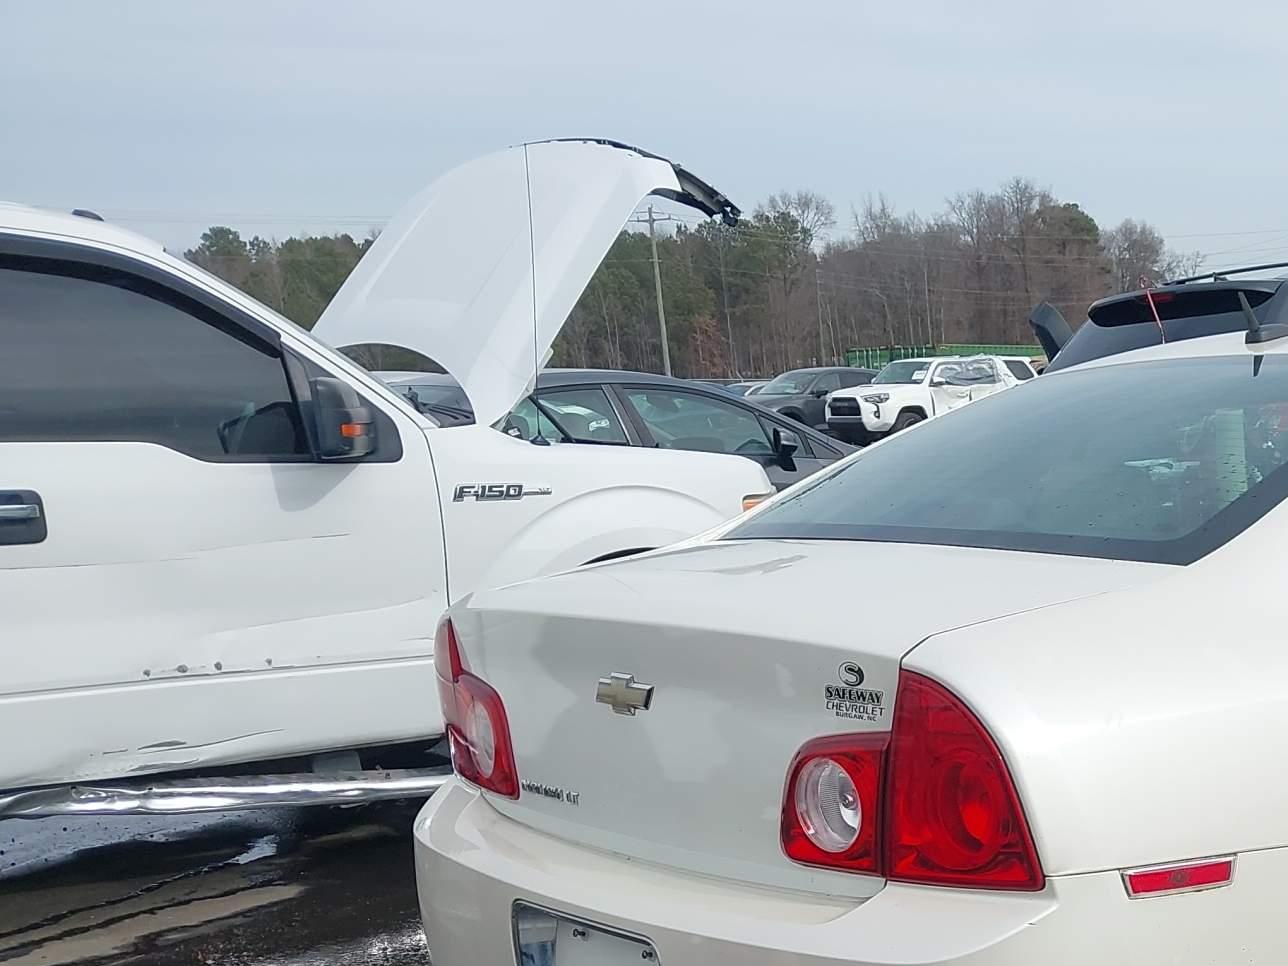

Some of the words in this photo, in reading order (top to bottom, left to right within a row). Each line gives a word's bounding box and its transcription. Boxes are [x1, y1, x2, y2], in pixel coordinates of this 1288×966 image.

[453, 484, 523, 502] F-150
[825, 685, 884, 706] SAFEWAY
[826, 701, 886, 717] CHEVROLET
